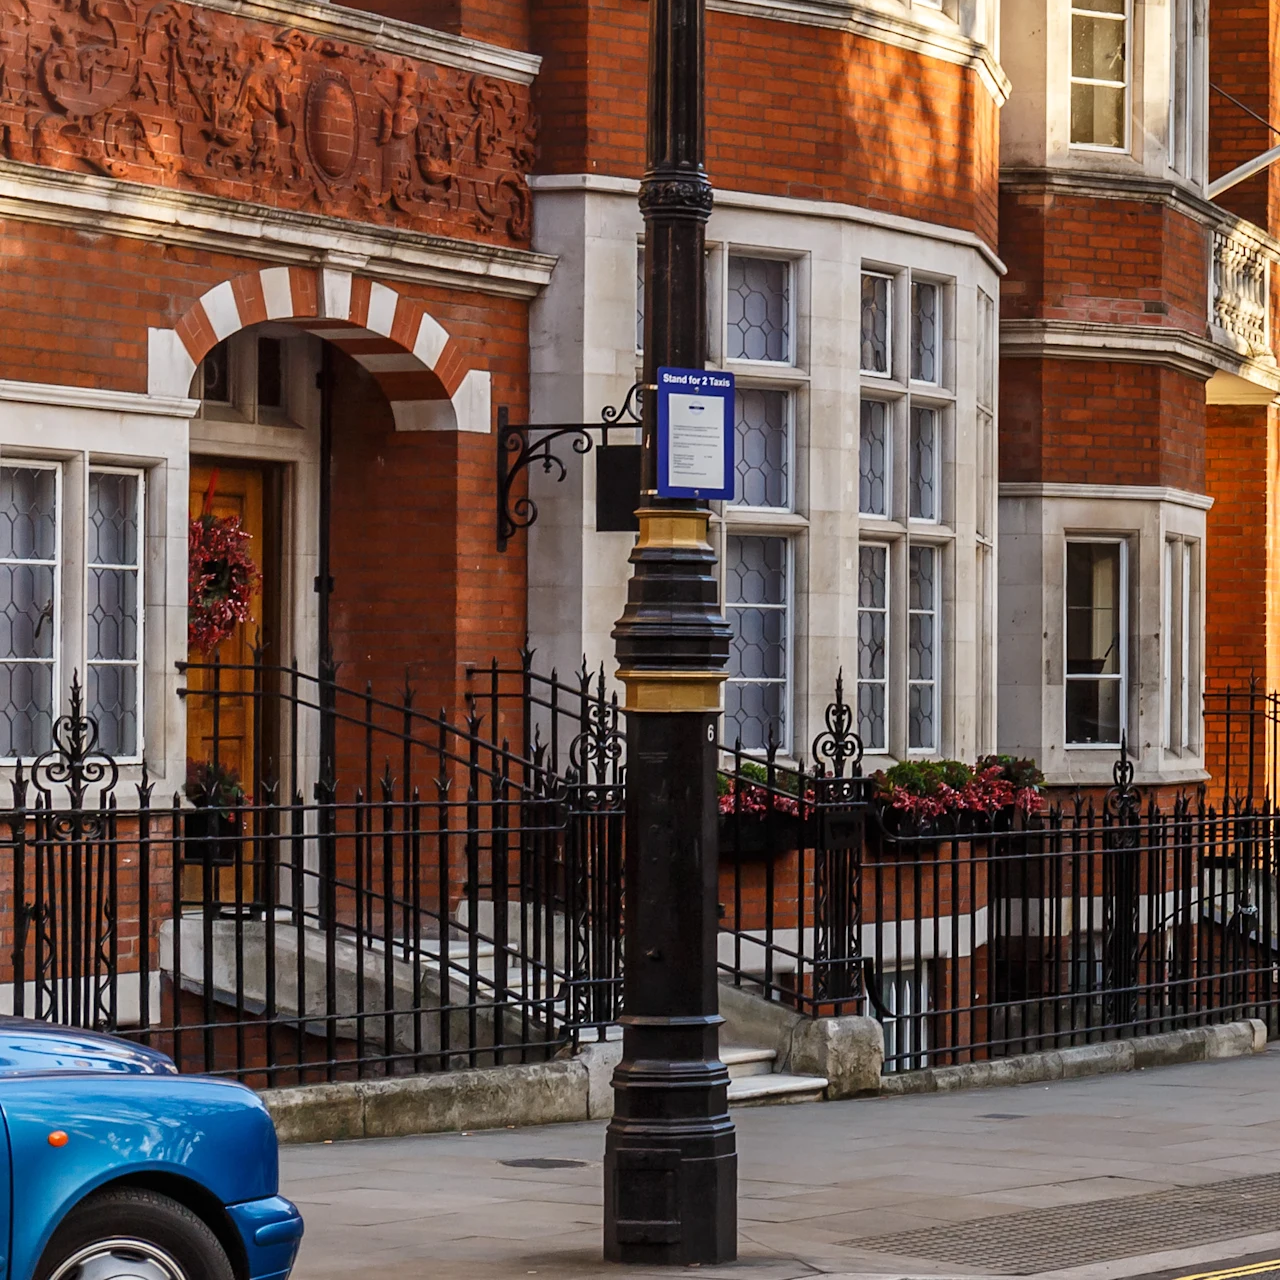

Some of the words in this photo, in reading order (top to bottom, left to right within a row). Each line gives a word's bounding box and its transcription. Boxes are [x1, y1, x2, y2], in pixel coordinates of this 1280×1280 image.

[663, 373, 687, 384] Stand
[688, 375, 700, 385] for
[701, 376, 708, 386] 2
[709, 377, 730, 387] Taxis
[707, 724, 714, 742] 6
